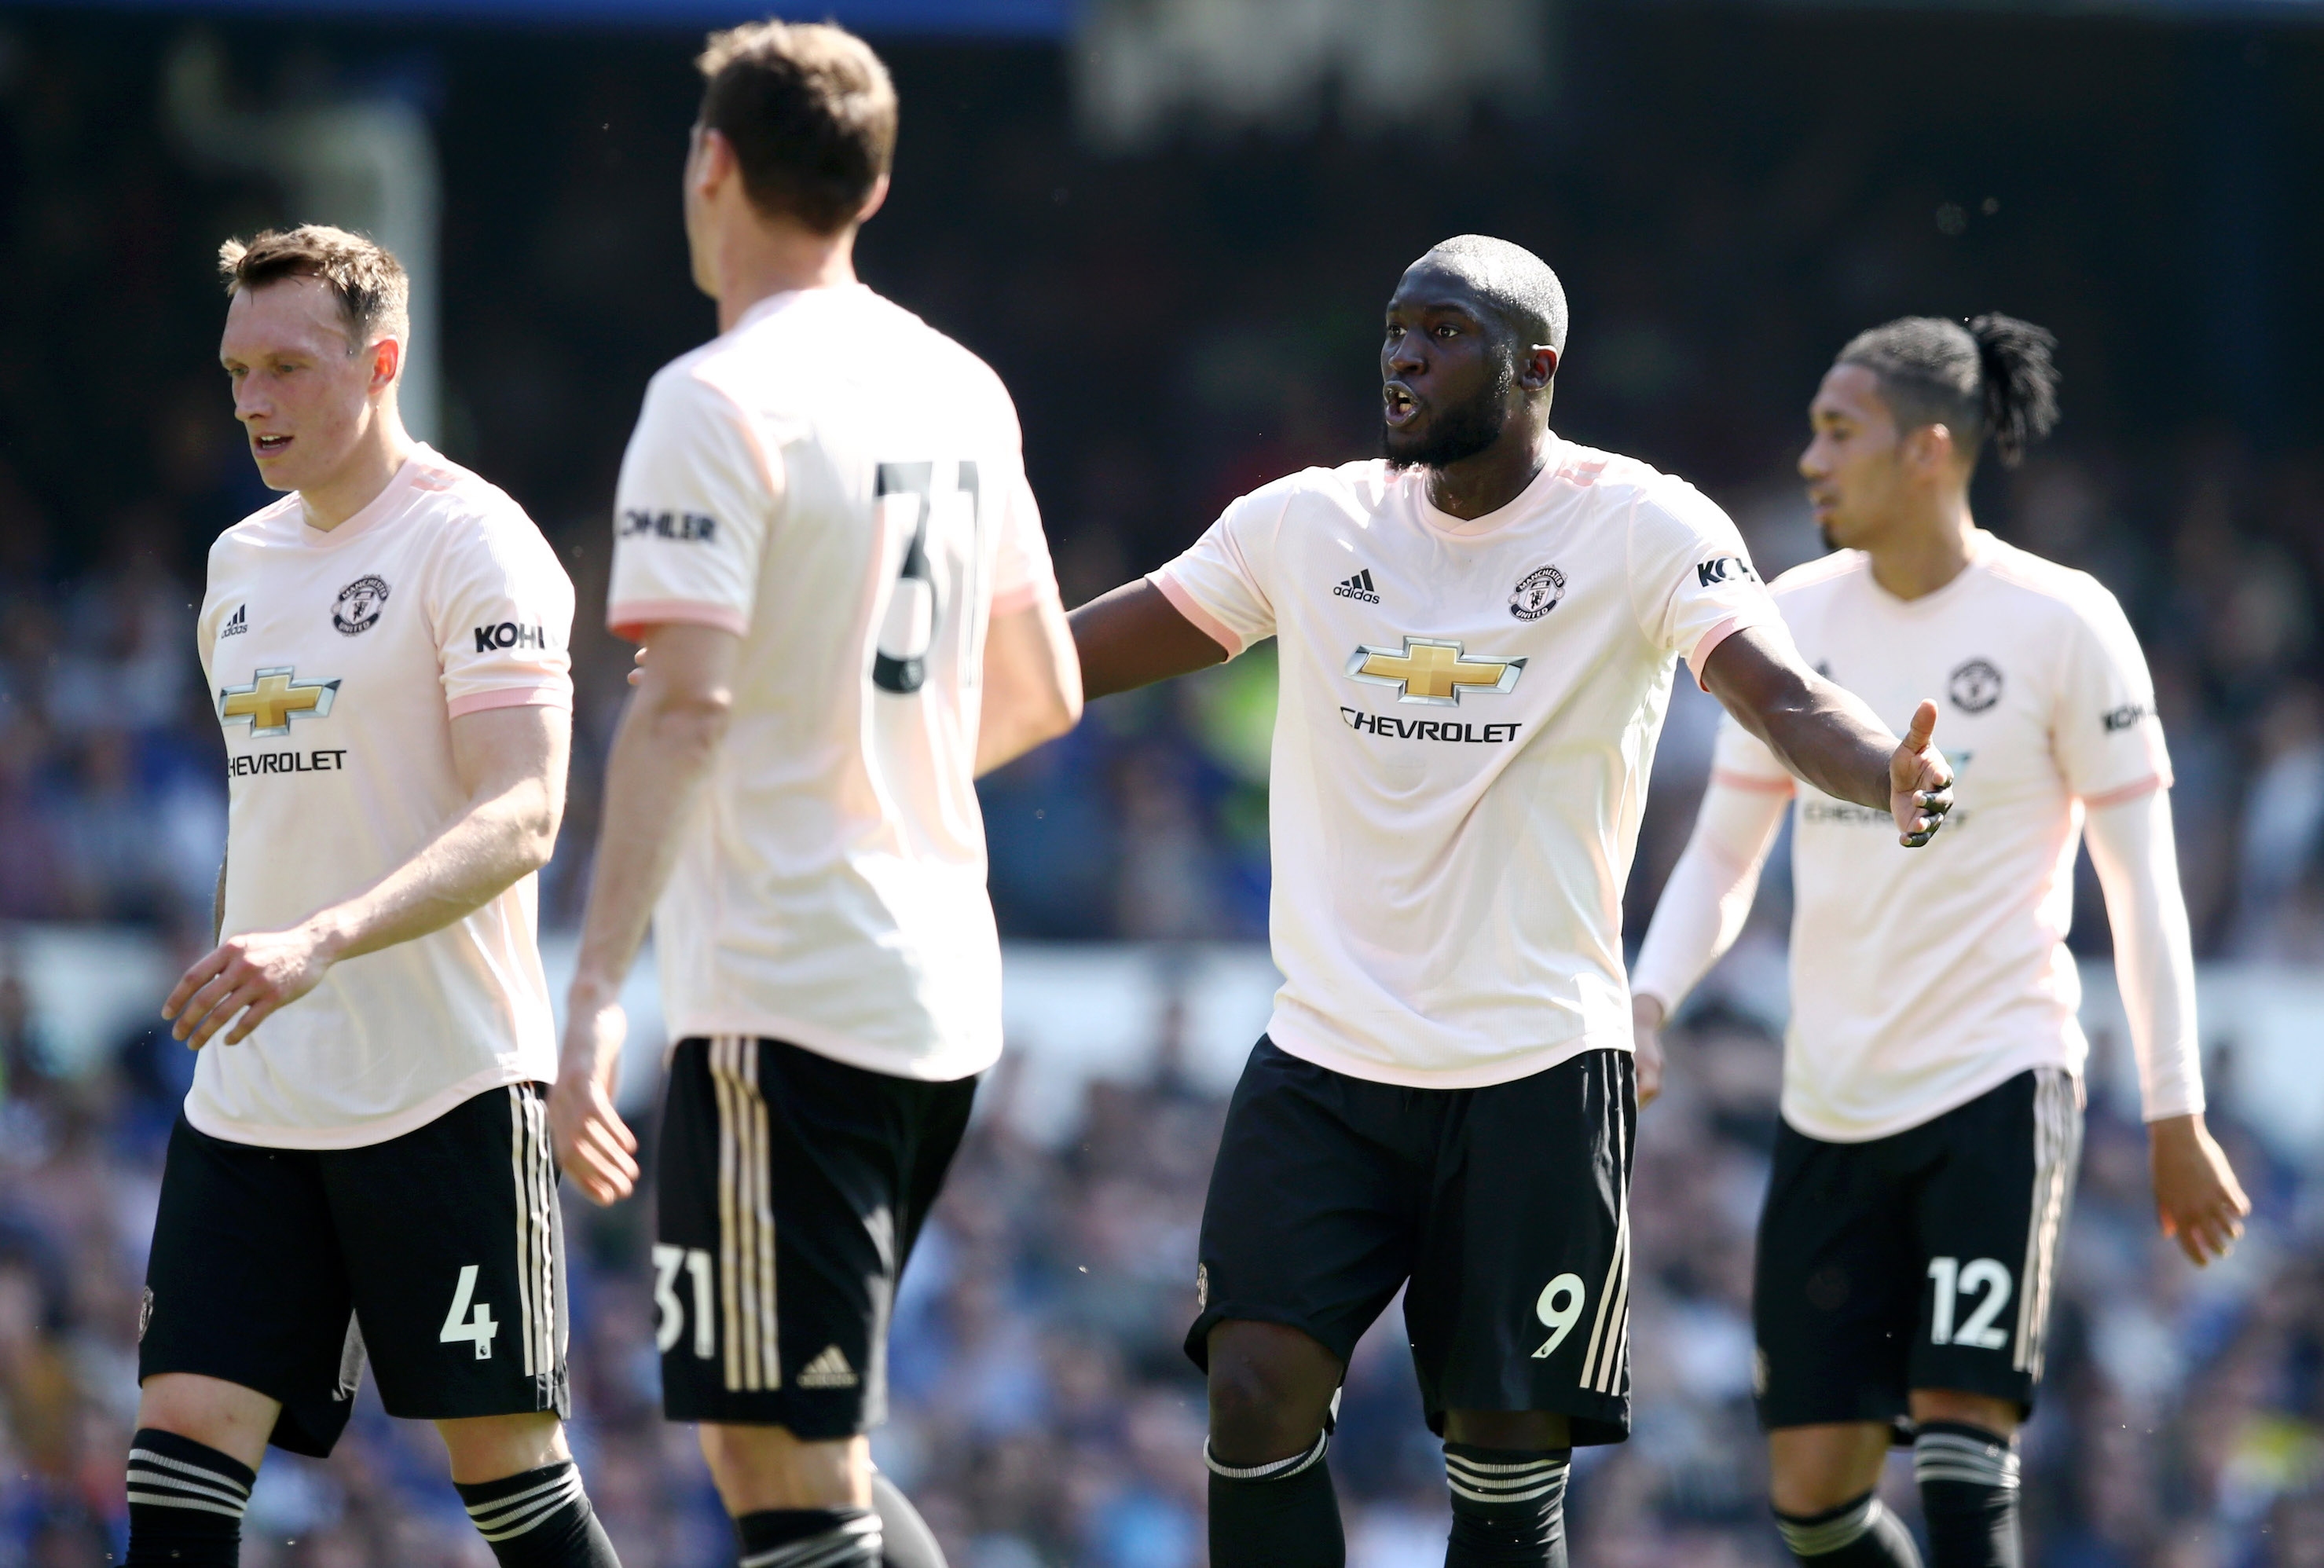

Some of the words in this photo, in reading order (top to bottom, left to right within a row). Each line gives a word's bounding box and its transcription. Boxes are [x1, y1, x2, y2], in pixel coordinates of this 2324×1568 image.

[623, 507, 718, 544] OHLER
[873, 460, 980, 694] 31
[1333, 586, 1380, 604] adidas
[1519, 569, 1563, 590] MANCHESTER
[1516, 607, 1549, 619] UNITED
[1340, 706, 1523, 743] CHEVROLET
[228, 749, 347, 779] HEVROLET
[439, 1265, 499, 1361] 4
[651, 1244, 715, 1360] 31
[1530, 1273, 1585, 1359] 9
[1927, 1257, 2013, 1350] 12
